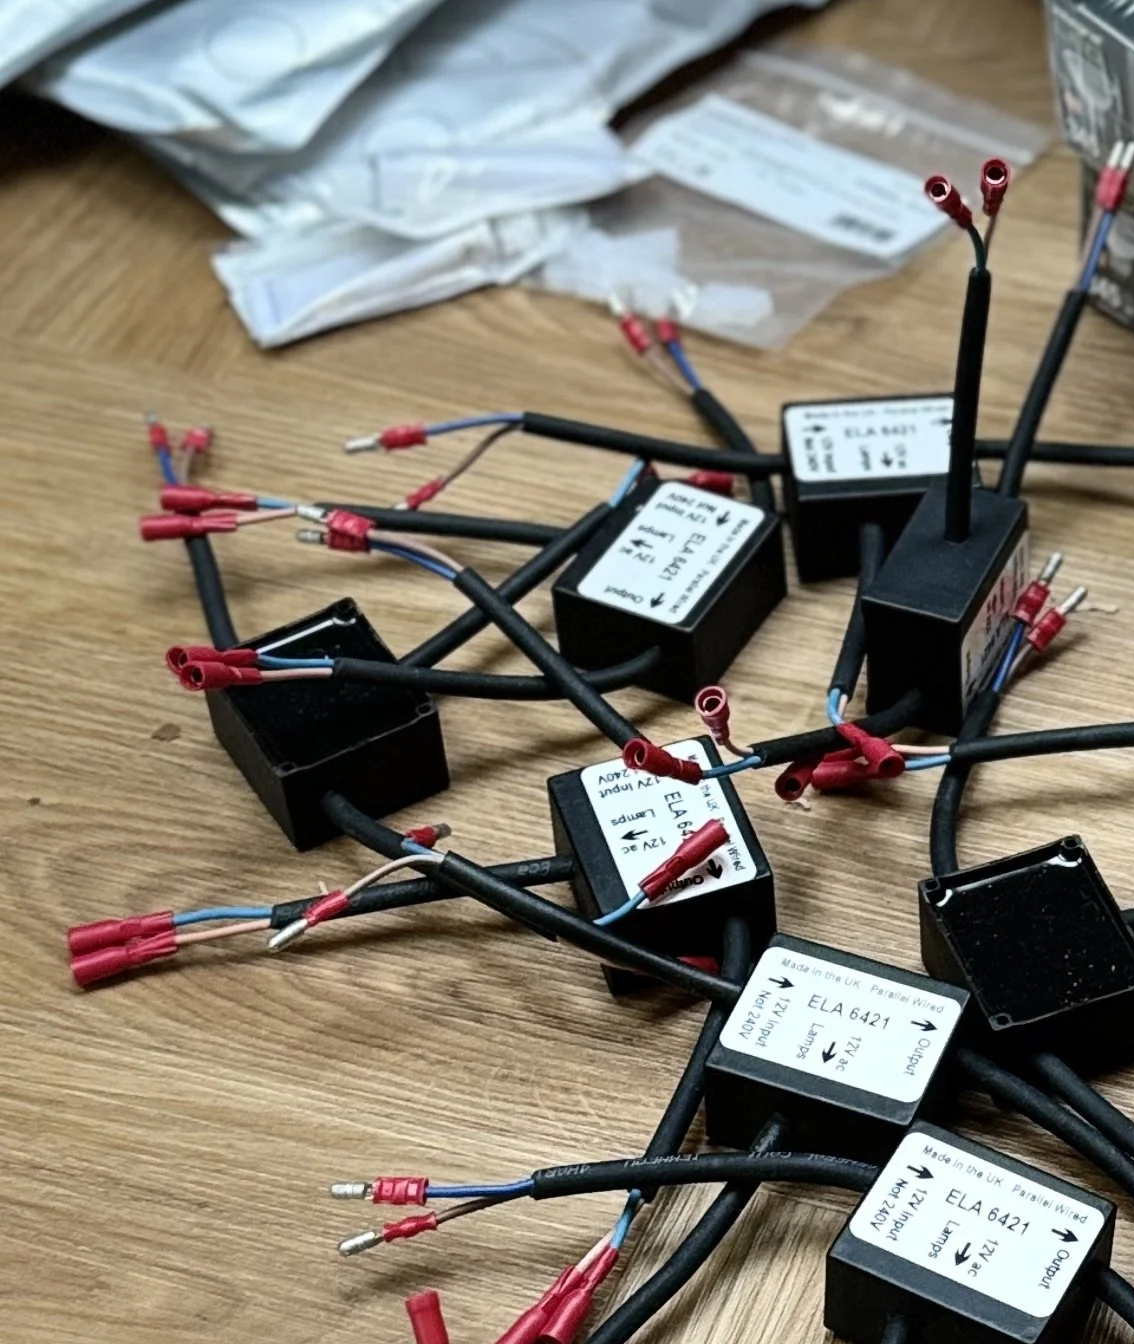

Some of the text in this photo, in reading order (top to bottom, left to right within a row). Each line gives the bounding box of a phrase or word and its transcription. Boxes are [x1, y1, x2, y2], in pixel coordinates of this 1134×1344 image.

[658, 531, 706, 582] ELA 6421
[598, 768, 631, 785] 240V
[610, 808, 657, 826] Lamps
[664, 791, 688, 820] ELA
[620, 836, 667, 855] 12V ac
[781, 957, 810, 973] Made
[823, 971, 842, 983] the
[845, 976, 862, 989] UK
[870, 984, 910, 1004] Parallel
[911, 997, 945, 1014] Wired
[738, 989, 772, 1041] Not 240V
[755, 997, 791, 1049] 12V Input
[807, 994, 890, 1030] ELA 6421
[796, 1022, 825, 1061] Lamps
[835, 1035, 863, 1072] 12V ac
[903, 1037, 931, 1077] Output
[869, 1177, 909, 1232] Not 240V
[922, 1145, 951, 1165] Made
[966, 1164, 984, 1180] the
[986, 1171, 1006, 1188] UK
[1010, 1184, 1054, 1209] Parallel
[1054, 1203, 1089, 1225] Wired
[886, 1188, 928, 1242] 12V Input
[944, 1188, 1031, 1237] ELA 6421
[928, 1219, 961, 1260] Lamps
[967, 1238, 1000, 1278] 12V ac
[1038, 1249, 1070, 1290] Output
